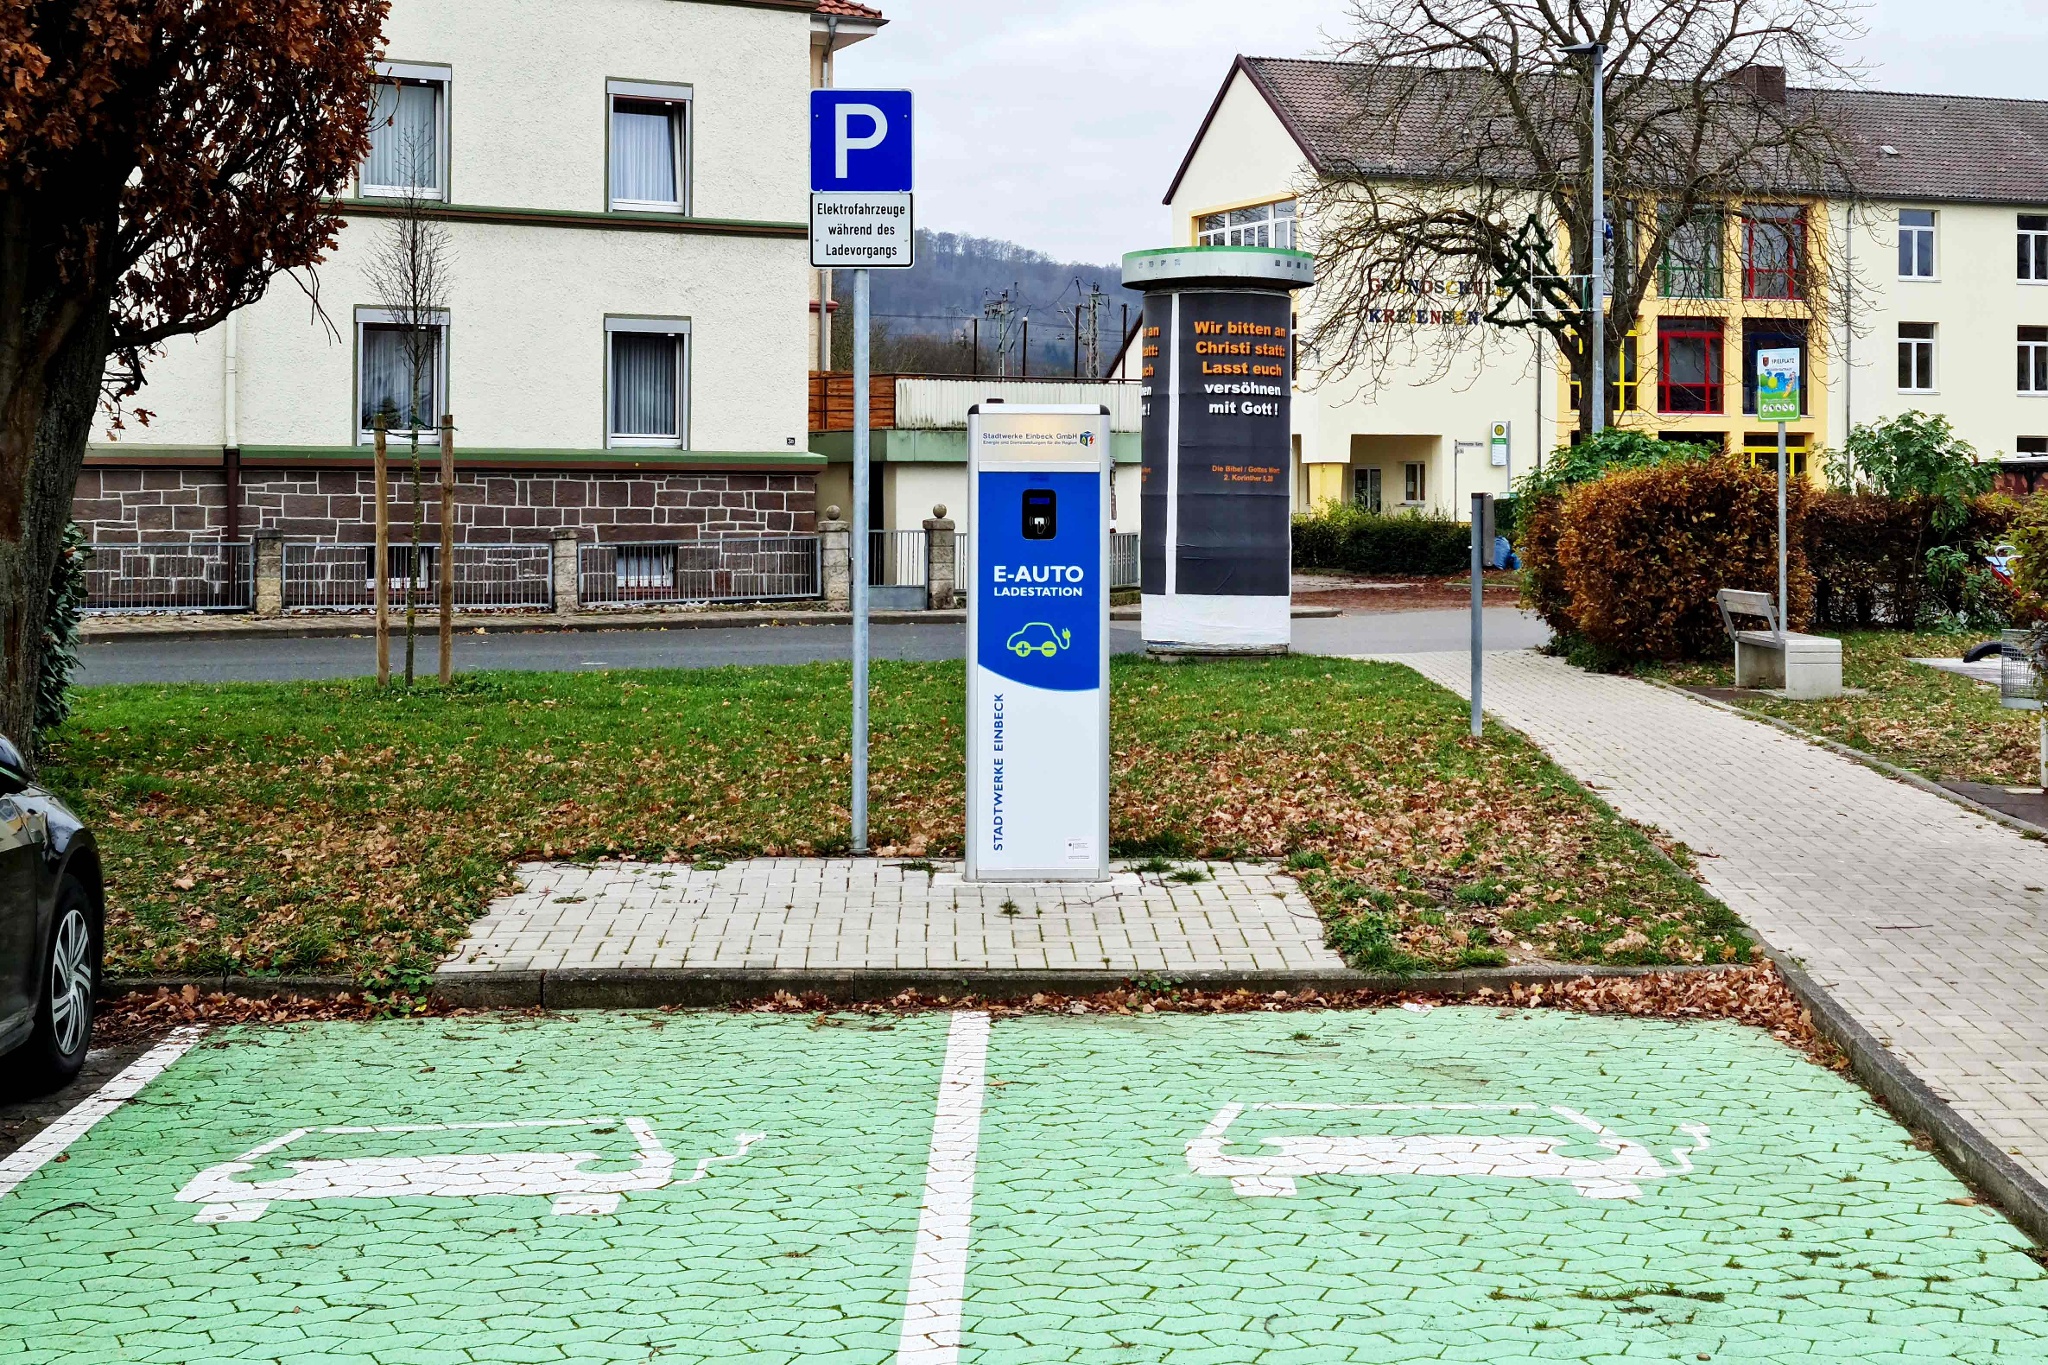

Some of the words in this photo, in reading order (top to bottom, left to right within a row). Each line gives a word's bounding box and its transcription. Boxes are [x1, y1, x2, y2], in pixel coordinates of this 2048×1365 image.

[835, 103, 888, 179] P
[817, 203, 906, 217] Elektrofahrzeuge
[828, 224, 872, 235] während
[877, 224, 895, 235] des
[826, 244, 897, 258] Ladevorgangs
[1194, 320, 1222, 334] Wir
[1228, 321, 1271, 336] bitten
[1274, 326, 1286, 337] an
[1196, 341, 1250, 354] Christi
[1255, 344, 1285, 358] statt:
[1202, 361, 1248, 374] Lasst
[1252, 364, 1282, 377] euch
[1204, 382, 1281, 396] versöhnen
[1208, 401, 1236, 414] mit
[994, 565, 1084, 583] E-AUTO
[994, 587, 1083, 597] LADESTATION
[994, 693, 1004, 751] EINBECK
[993, 758, 1003, 851] STADTWERKE
